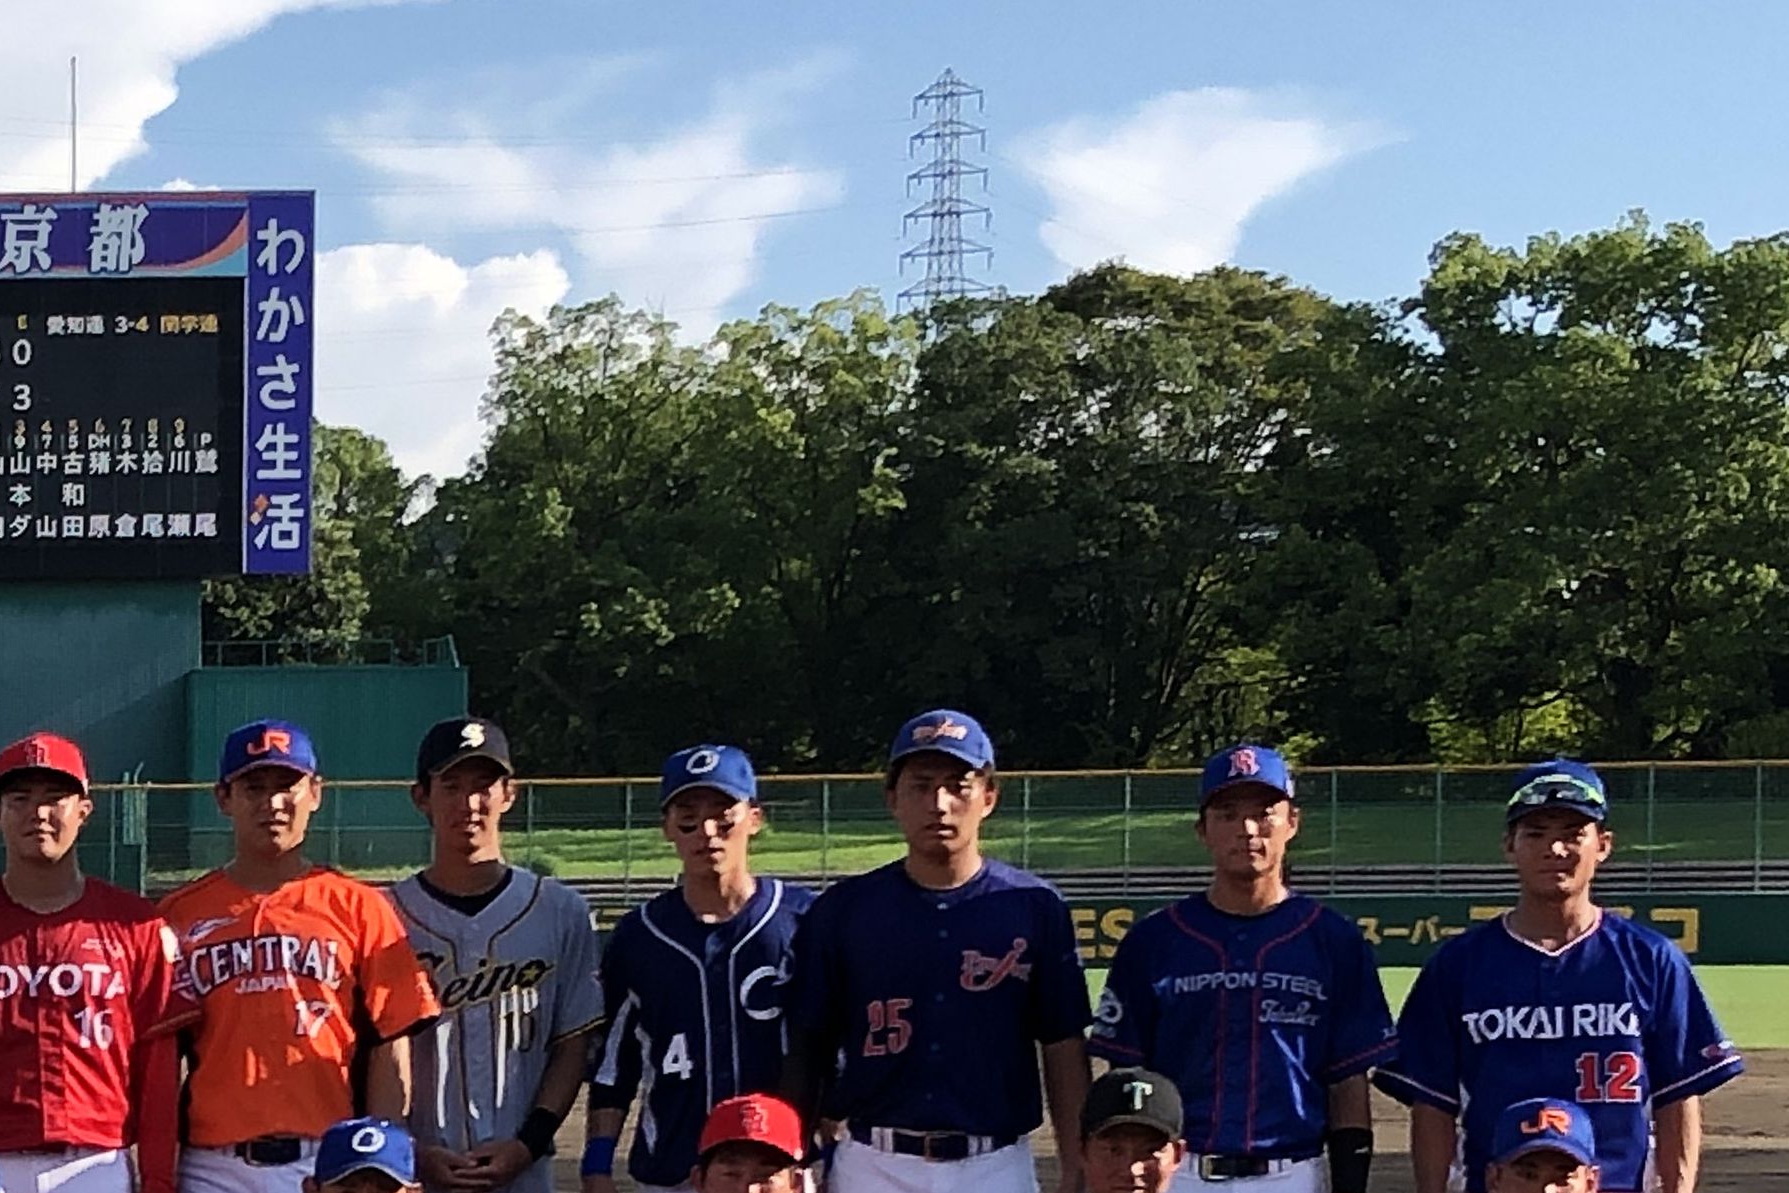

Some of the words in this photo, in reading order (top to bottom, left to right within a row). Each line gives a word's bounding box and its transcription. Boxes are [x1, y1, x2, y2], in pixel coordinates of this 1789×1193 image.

[12, 338, 32, 365] 0
[12, 384, 31, 411] 3
[254, 217, 306, 552] わかさ生活
[246, 729, 292, 755] JR
[190, 934, 342, 997] CENTRAL
[1174, 970, 1257, 993] NIPPON
[1262, 972, 1328, 1000] STEEL
[75, 1007, 115, 1049] 16
[863, 998, 912, 1057] 25
[1463, 1005, 1563, 1043] TOKAI
[662, 1033, 694, 1080] 4
[1123, 1081, 1153, 1110] T
[1575, 1052, 1642, 1103] 12
[1520, 1108, 1573, 1136] JR
